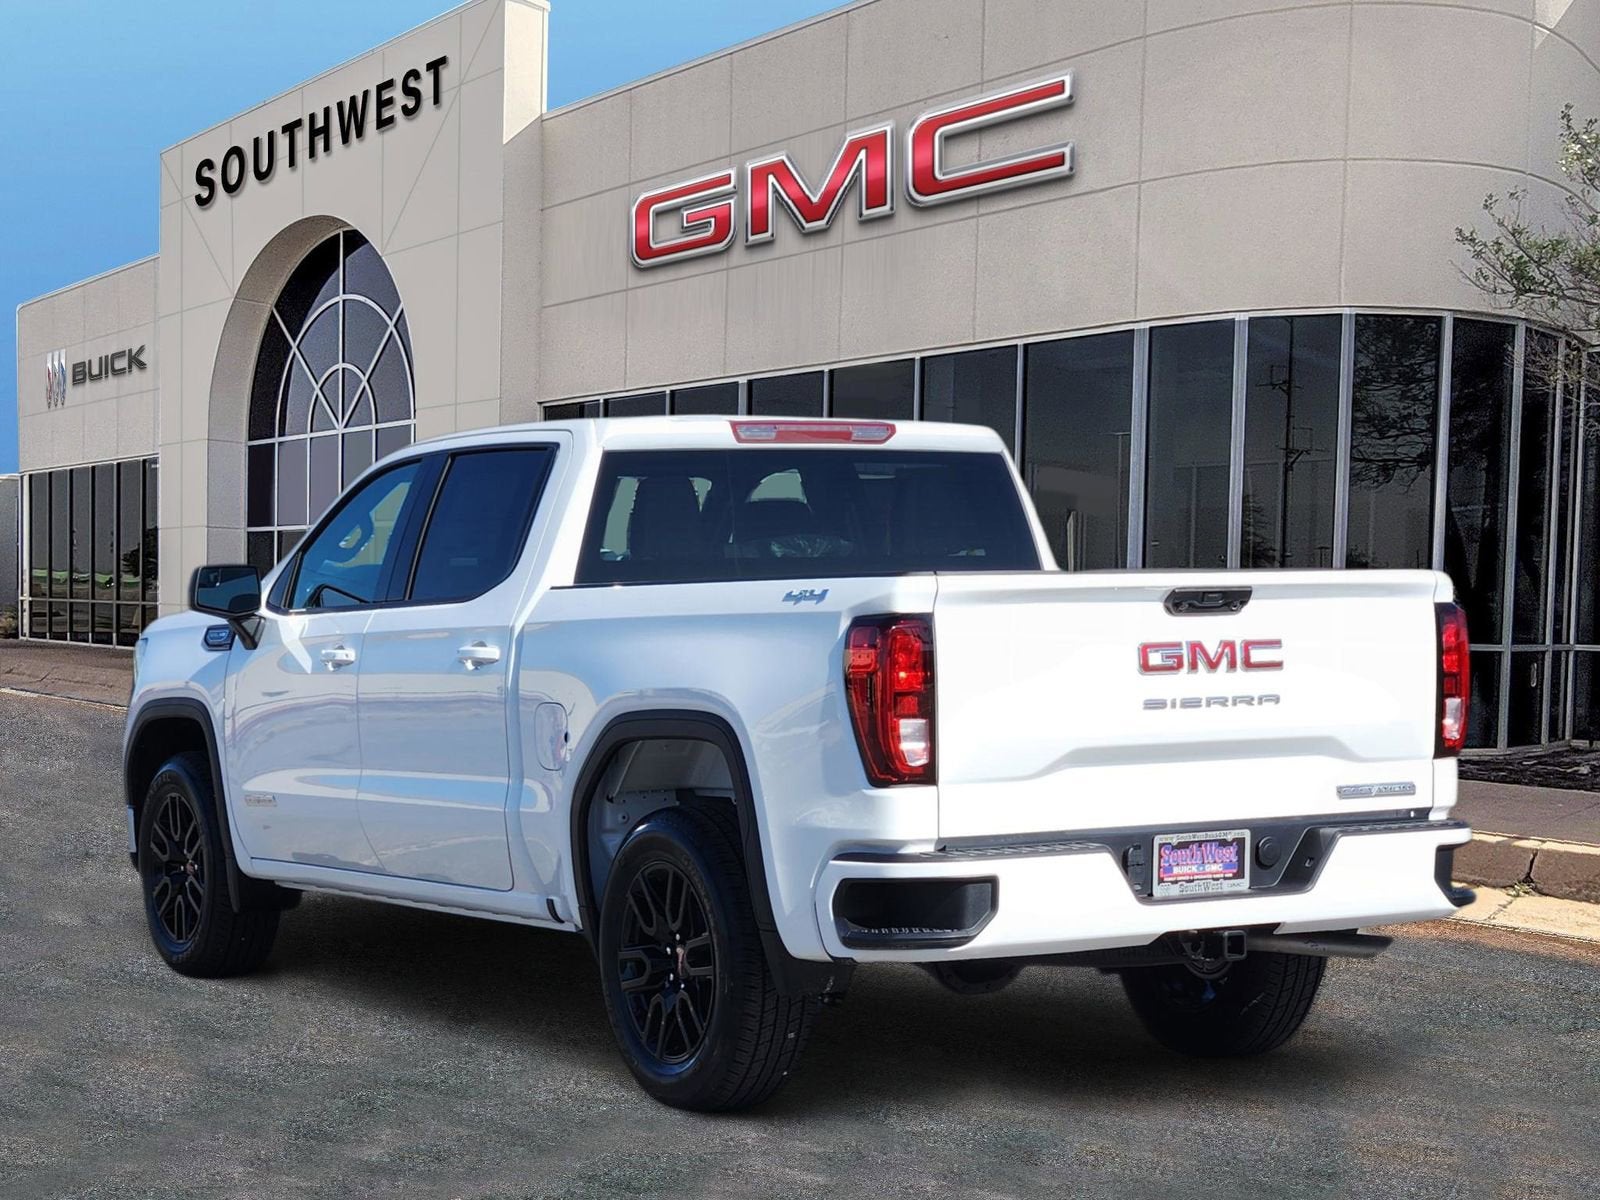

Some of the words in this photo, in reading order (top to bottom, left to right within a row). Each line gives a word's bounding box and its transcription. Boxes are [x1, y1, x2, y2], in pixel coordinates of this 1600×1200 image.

[194, 55, 449, 208] SOUTHWEST
[630, 68, 1076, 269] GMC
[72, 344, 147, 386] BUICK
[1138, 638, 1284, 676] GMC
[1142, 693, 1281, 710] SIERRA
[1172, 863, 1198, 874] BUICK
[1204, 863, 1224, 872] GMC
